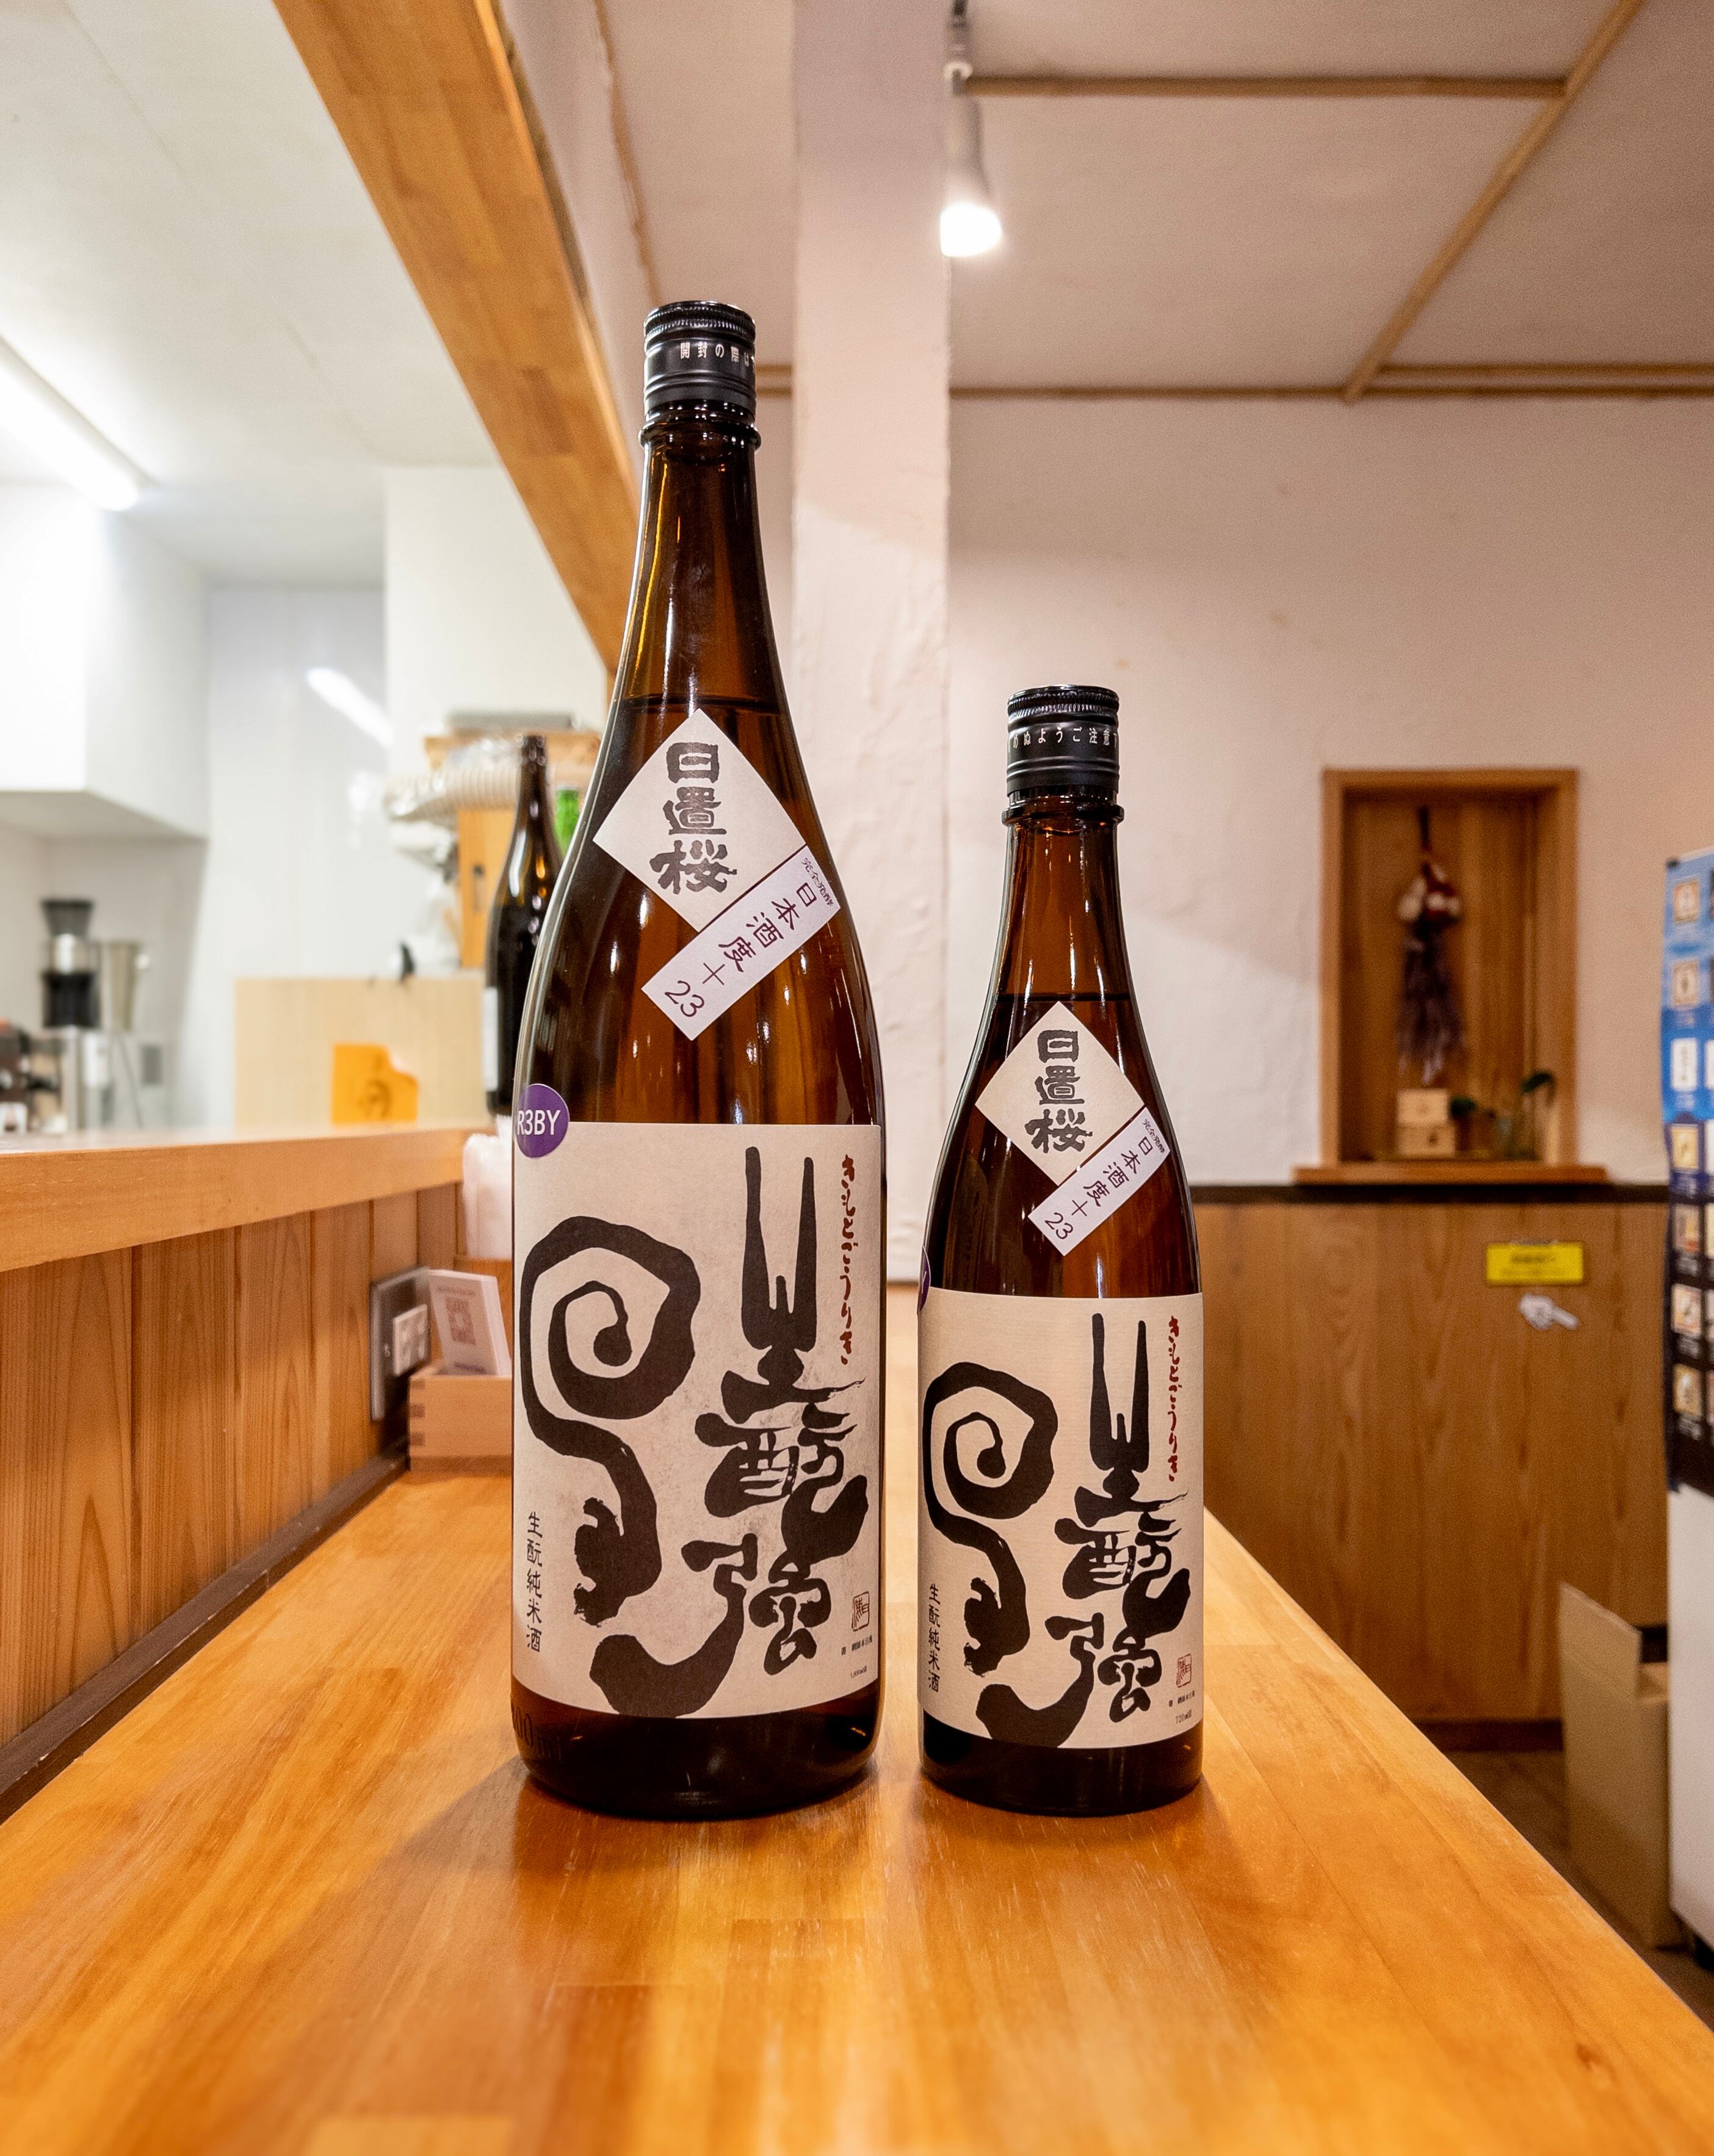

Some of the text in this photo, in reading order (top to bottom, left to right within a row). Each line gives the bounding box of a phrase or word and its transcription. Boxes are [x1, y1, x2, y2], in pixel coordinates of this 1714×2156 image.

[680, 341, 754, 367] 開封の際は
[517, 1109, 561, 1135] R3BY
[526, 1511, 543, 1653] 生酛純米酒
[928, 1583, 941, 1693] 生酛純米酒
